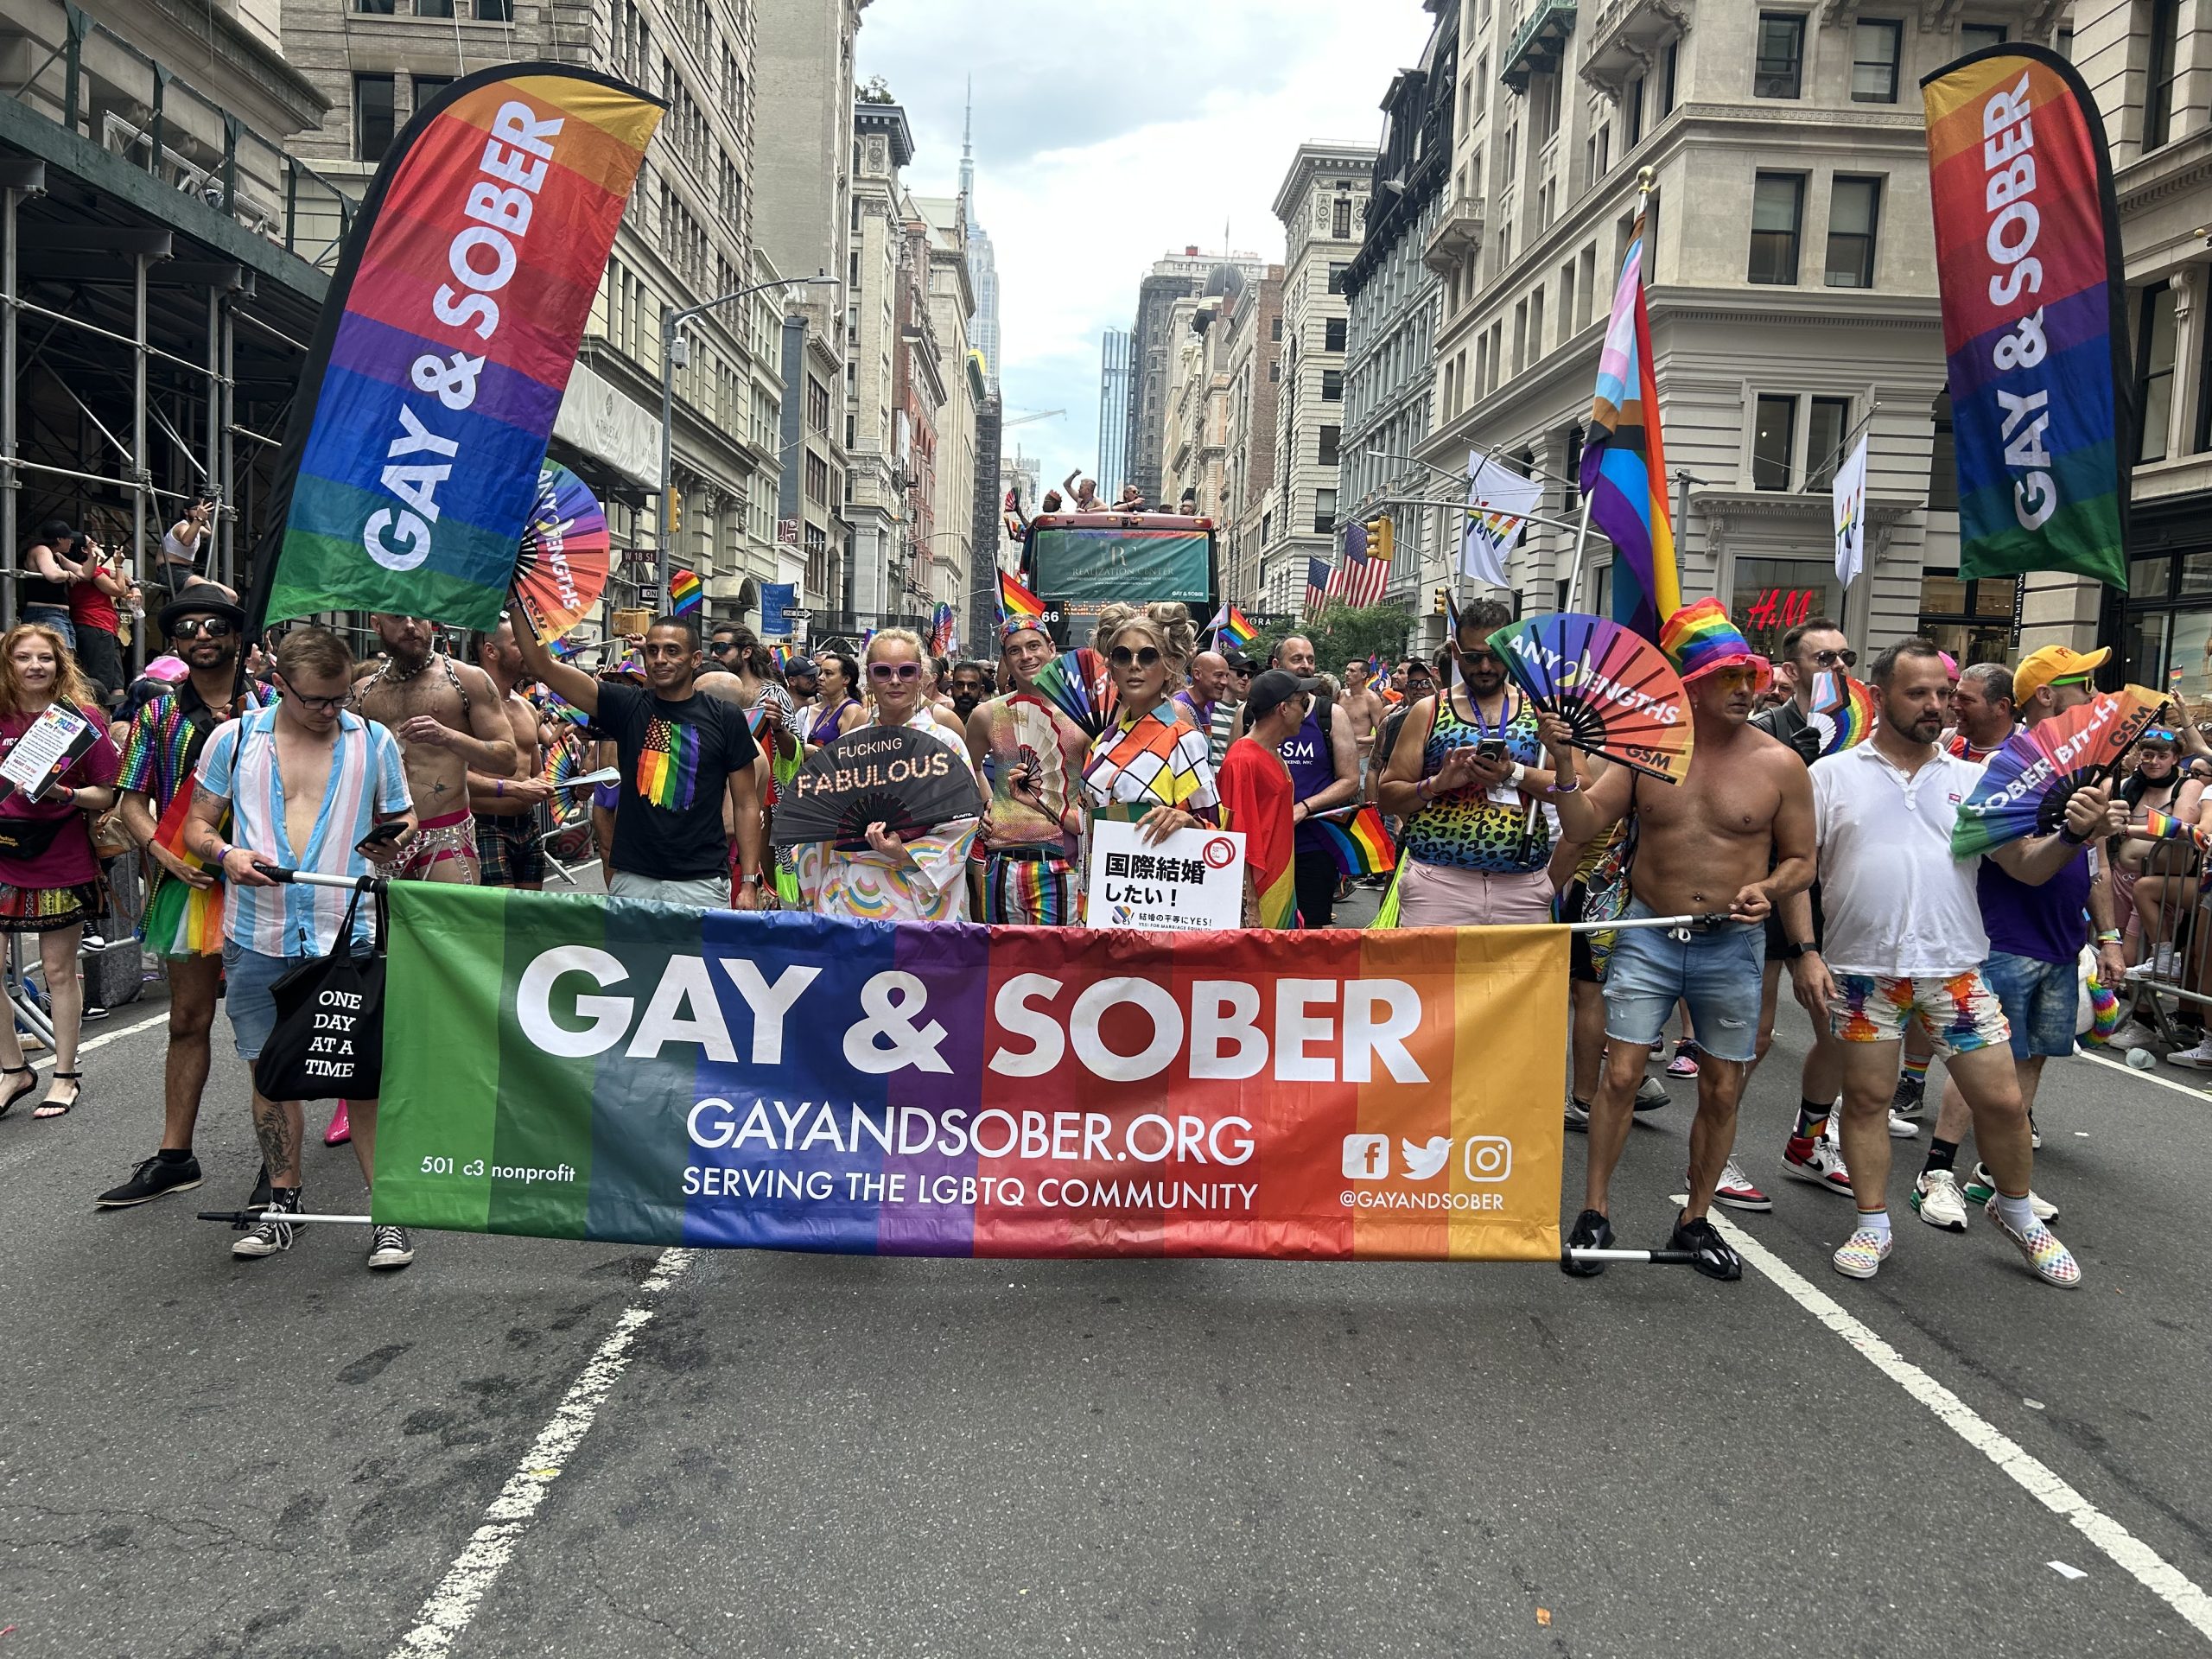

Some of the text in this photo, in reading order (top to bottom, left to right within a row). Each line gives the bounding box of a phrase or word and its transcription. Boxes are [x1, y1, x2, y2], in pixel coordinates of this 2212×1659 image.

[1983, 70, 2056, 531] GAY & SOBER
[363, 100, 565, 571] GAY & SOBER
[537, 469, 558, 512] ANY
[625, 552, 653, 562] W 18 St
[1072, 567, 1174, 576] REALIZATION CENTER
[1041, 611, 1059, 622] 66
[1745, 588, 1813, 632] H&M
[1507, 634, 1563, 670] ANY
[2108, 706, 2153, 747] GSM
[837, 737, 903, 760] FUCKING
[1625, 744, 1671, 770] GSM
[797, 752, 950, 798] FABULOUS
[1967, 757, 2056, 817] SOBER
[1104, 852, 1206, 885] 国際結婚
[1105, 882, 1177, 907] したい！
[319, 990, 363, 1009] ONE
[517, 944, 1430, 1084] GAY & SOBER
[314, 1014, 356, 1032] DAY
[308, 1037, 354, 1055] AT A
[305, 1059, 355, 1077] TIME
[686, 1097, 1255, 1166] GAYANDSOBER.ORG
[420, 1155, 576, 1184] 501 c3 nonprofit
[681, 1166, 1259, 1211] SERVING THE LGBTQ COMMUNITY
[1340, 1190, 1503, 1211] @GAYANDSOBER
